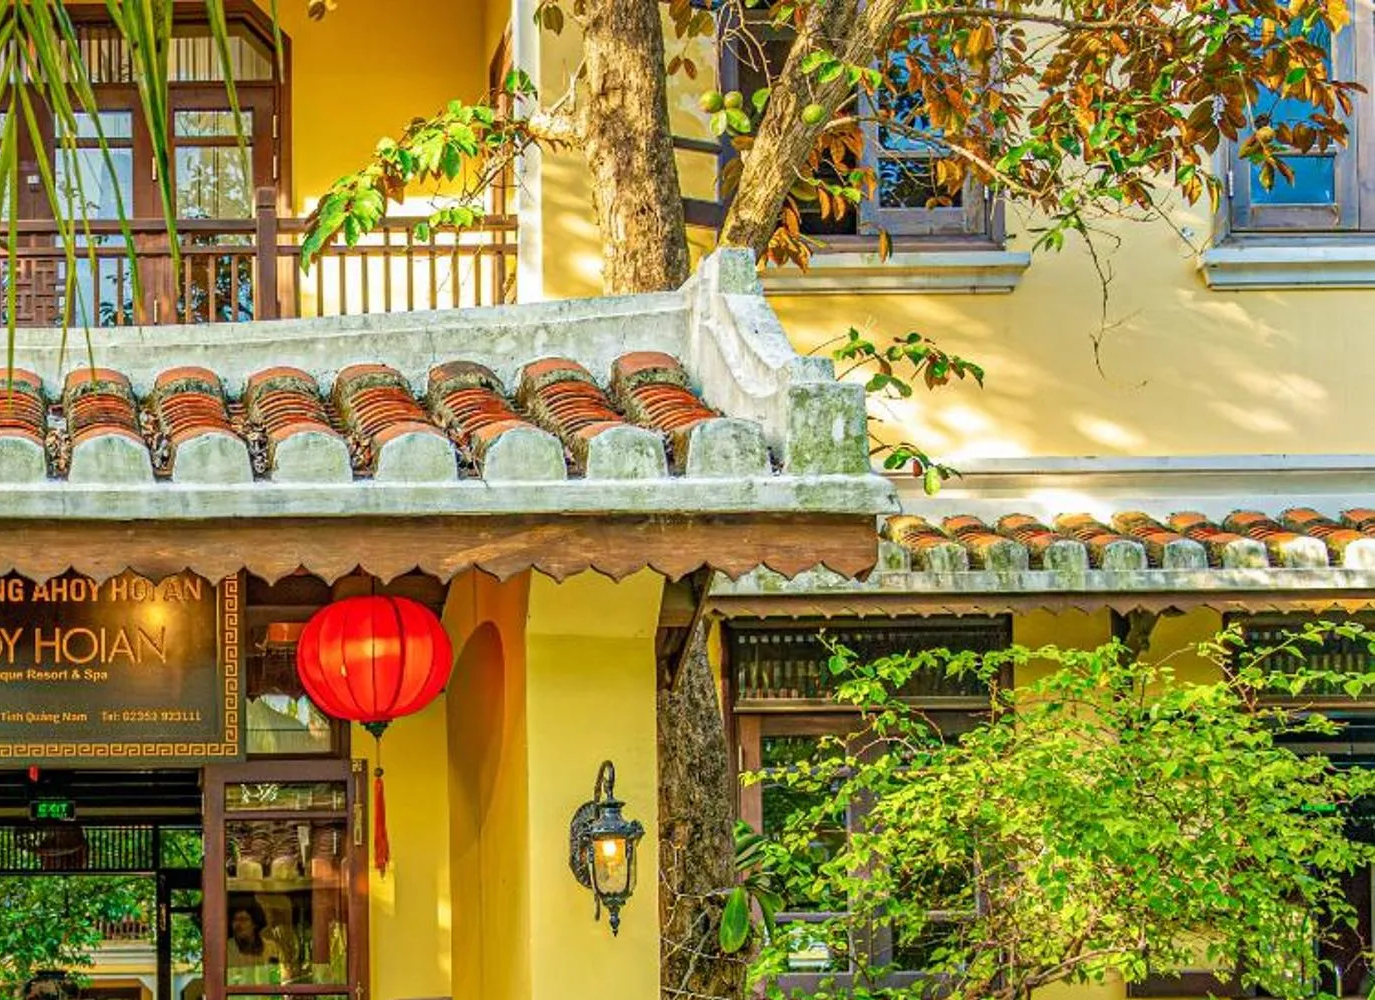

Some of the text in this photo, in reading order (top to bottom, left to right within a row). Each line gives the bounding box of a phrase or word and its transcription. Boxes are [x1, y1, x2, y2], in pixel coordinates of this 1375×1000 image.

[32, 578, 99, 602] AHOY
[27, 668, 68, 680] Resort
[72, 669, 81, 680] &
[84, 669, 108, 682] Spa
[62, 712, 87, 722] Nam
